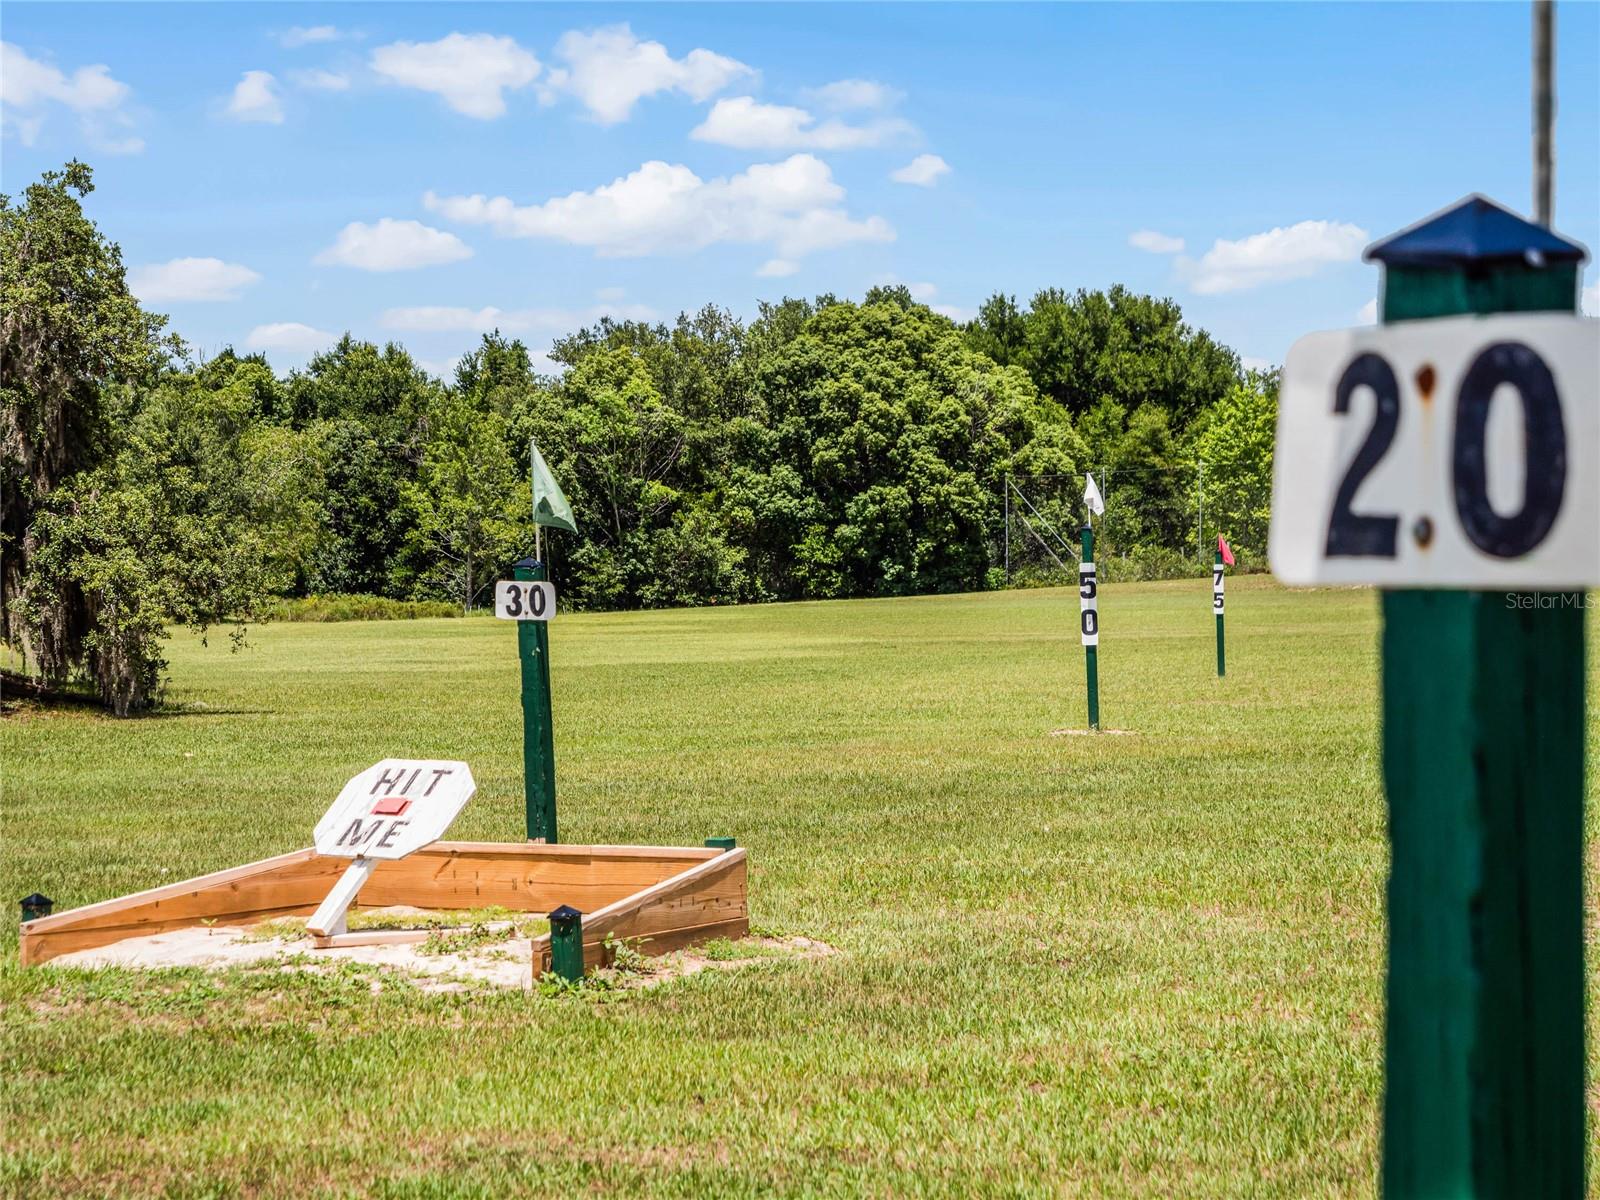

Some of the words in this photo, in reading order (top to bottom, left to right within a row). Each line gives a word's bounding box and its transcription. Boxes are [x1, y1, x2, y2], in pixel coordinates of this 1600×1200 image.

[1323, 340, 1568, 559] 20
[505, 584, 546, 617] 30
[369, 768, 454, 797] HIT
[336, 818, 411, 848] ME
